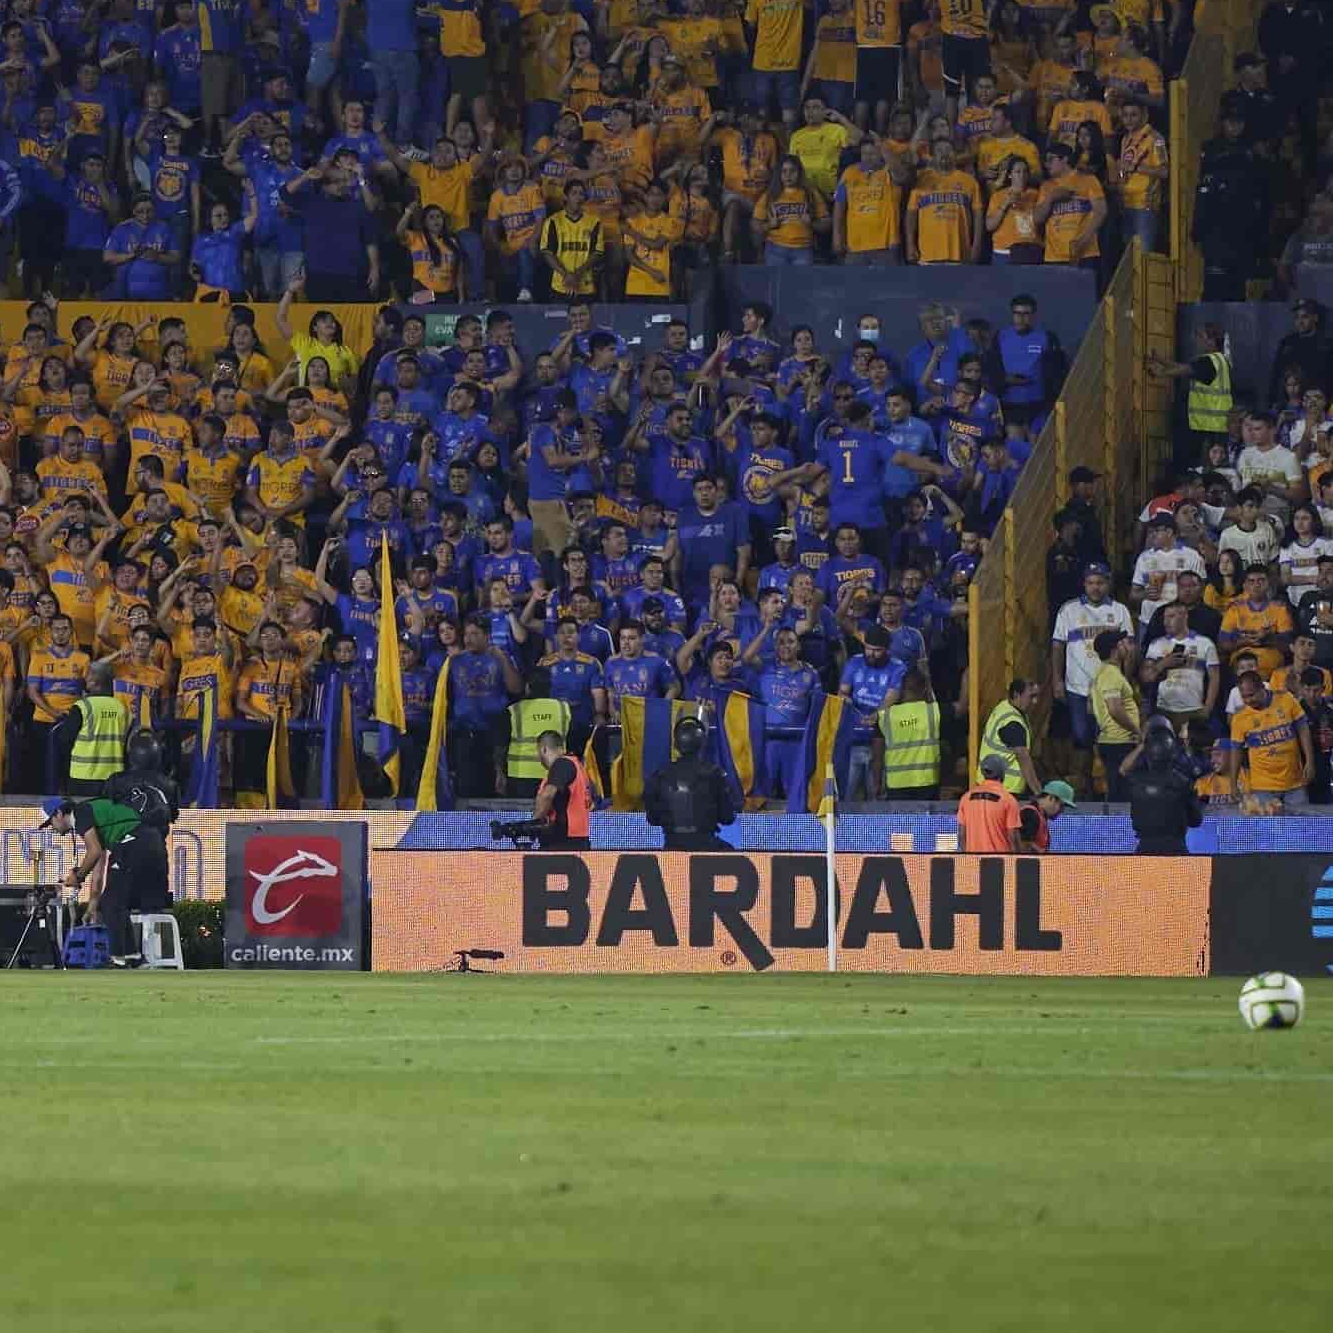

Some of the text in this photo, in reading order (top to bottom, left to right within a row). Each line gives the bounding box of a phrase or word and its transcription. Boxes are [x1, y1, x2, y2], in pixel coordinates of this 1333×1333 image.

[842, 450, 853, 483] 1
[532, 713, 552, 722] STAFF
[898, 718, 919, 729] STAFF
[521, 854, 1064, 972] BARDAHL
[231, 945, 354, 965] caliente.mx
